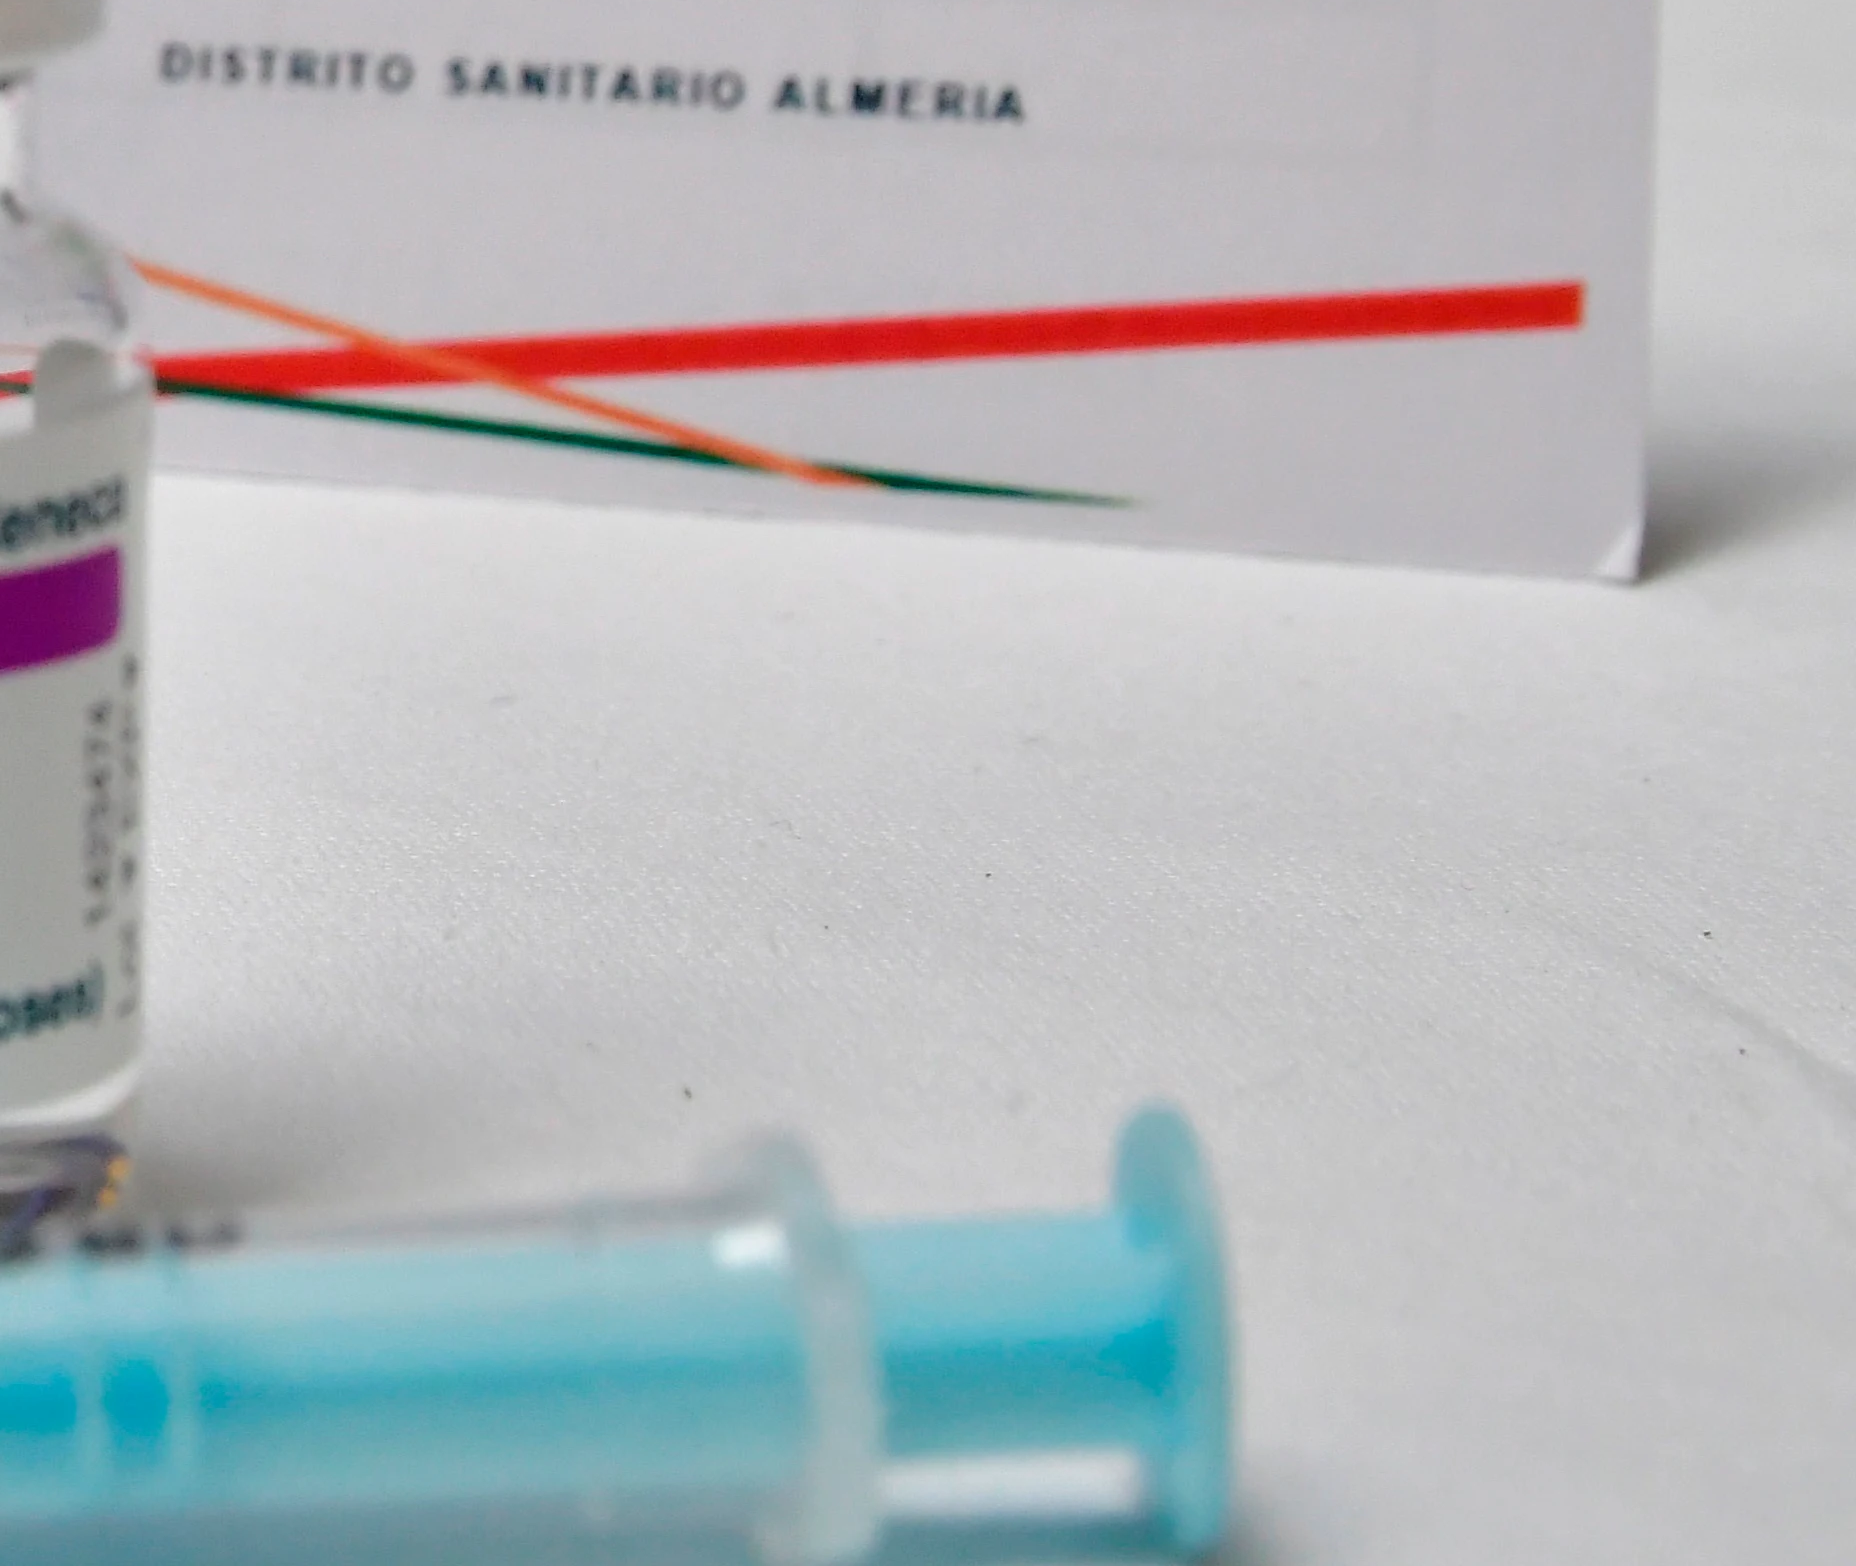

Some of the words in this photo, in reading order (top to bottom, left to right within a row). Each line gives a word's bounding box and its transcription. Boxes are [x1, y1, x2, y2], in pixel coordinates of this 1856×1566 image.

[158, 39, 414, 96] DISTRITO
[443, 56, 747, 119] SANITARIO
[771, 72, 1027, 129] ALMERIA
